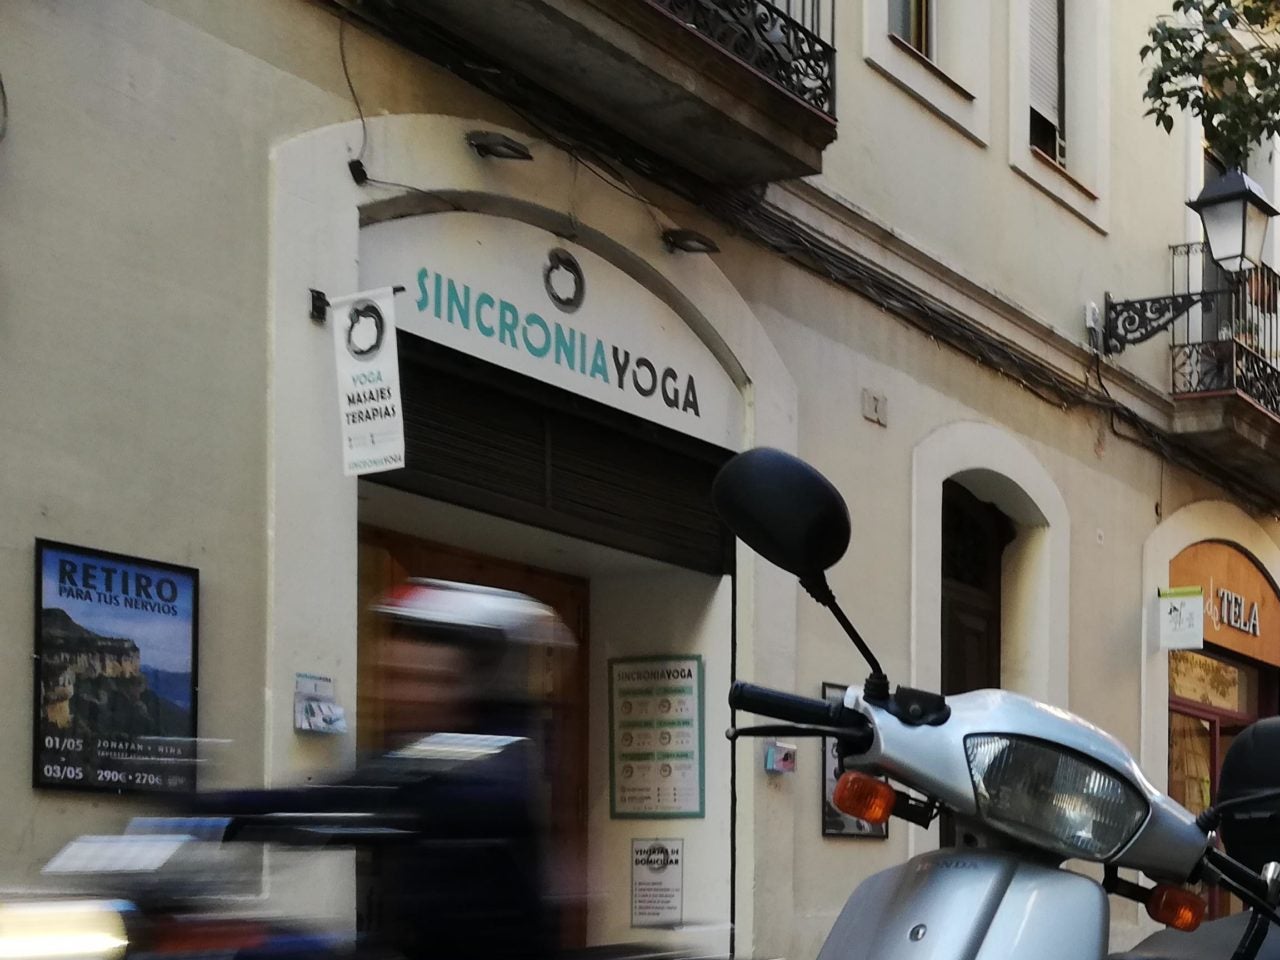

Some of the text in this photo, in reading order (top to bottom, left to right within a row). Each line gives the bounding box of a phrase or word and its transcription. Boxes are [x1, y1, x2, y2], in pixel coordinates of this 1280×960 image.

[352, 370, 382, 387] YOGA
[346, 386, 392, 405] MASAJES
[345, 404, 396, 425] TERAPIAS
[58, 559, 178, 603] RETIRO
[58, 585, 178, 616] PARA TUS NERVIOS
[1217, 588, 1260, 637] TELA
[44, 736, 84, 751] 01/05
[43, 764, 84, 780] 03/05
[634, 858, 679, 866] DOMICILIAR
